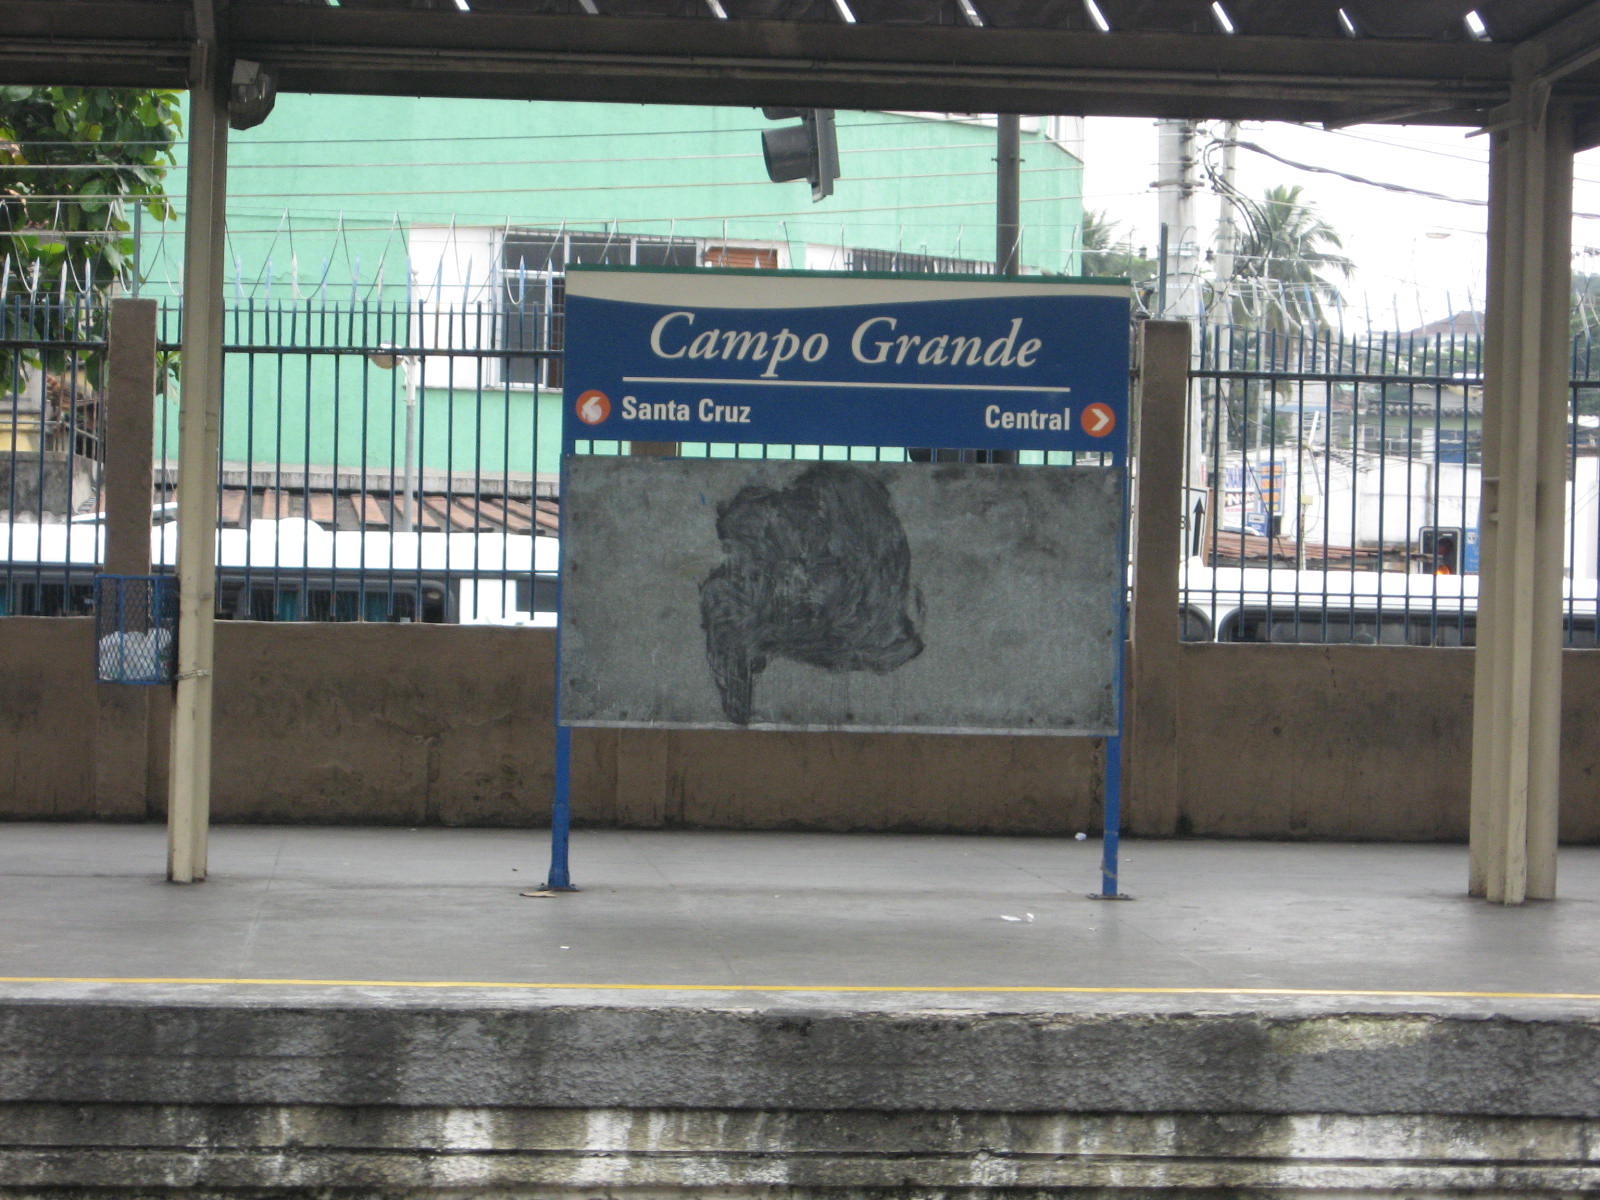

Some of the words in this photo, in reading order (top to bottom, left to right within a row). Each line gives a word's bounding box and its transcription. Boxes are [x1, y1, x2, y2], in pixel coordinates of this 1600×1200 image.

[650, 311, 829, 378] Campo
[851, 316, 1042, 368] Grande
[621, 395, 690, 421] Santa
[698, 398, 751, 423] Cruz
[985, 404, 1070, 431] Central
